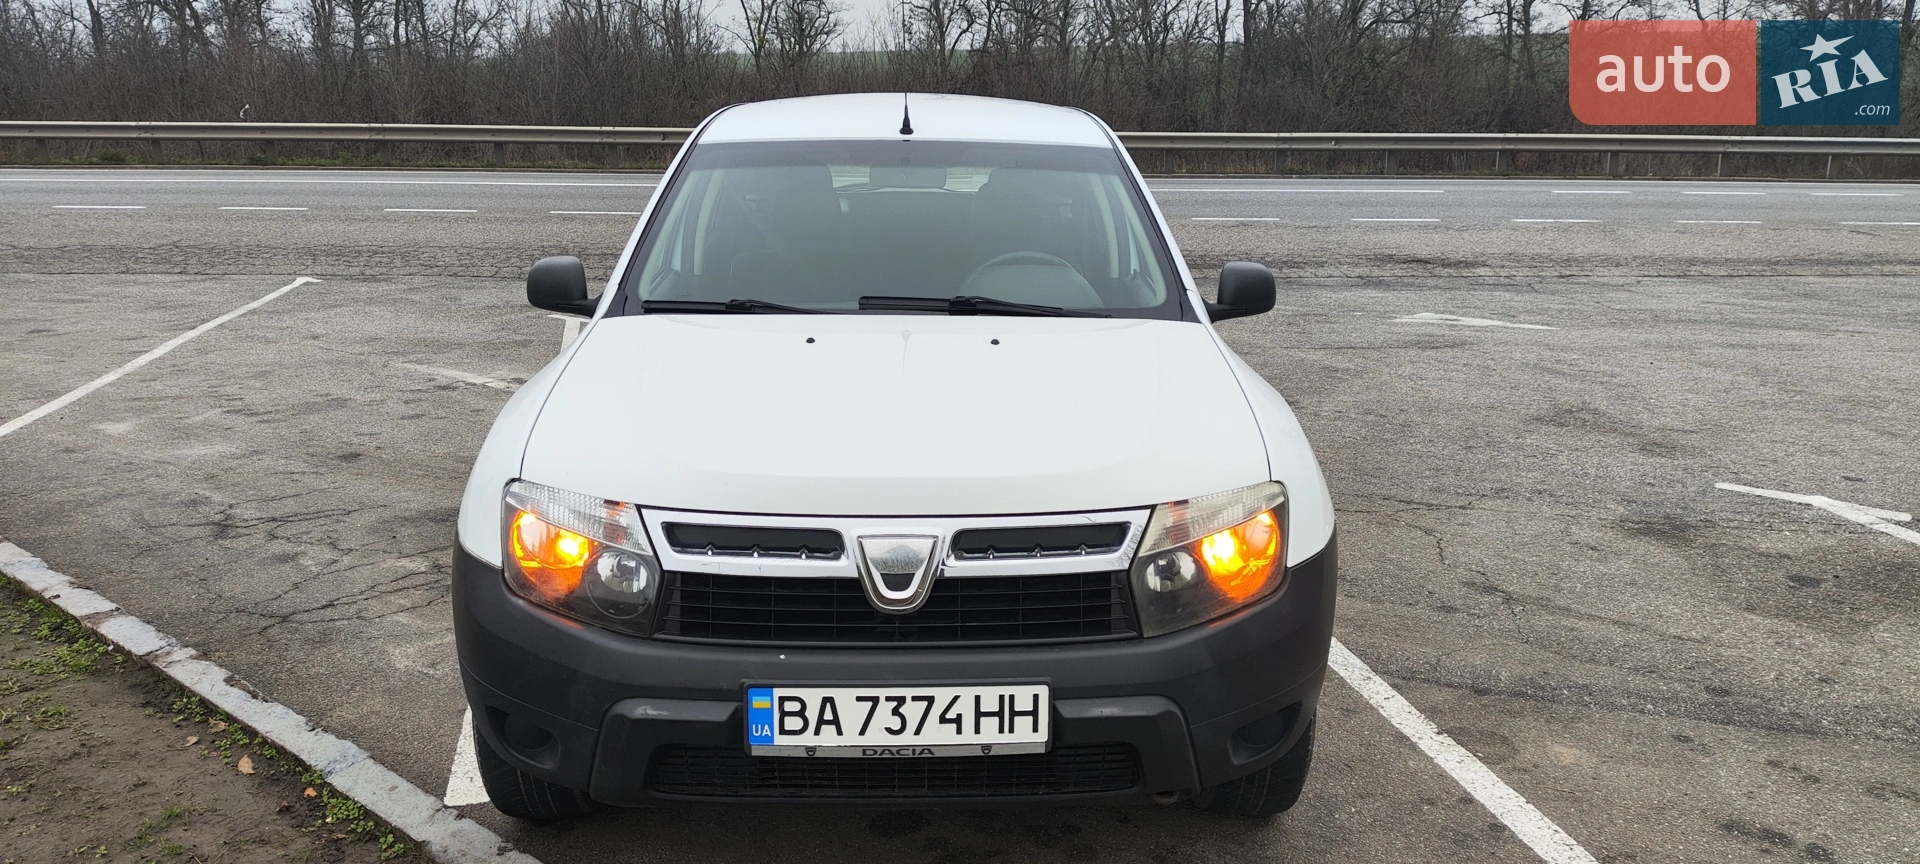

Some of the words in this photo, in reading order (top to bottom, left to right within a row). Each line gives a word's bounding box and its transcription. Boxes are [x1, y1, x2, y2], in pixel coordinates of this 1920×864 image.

[778, 695, 844, 736] BA
[855, 694, 963, 736] 7374
[974, 693, 1040, 735] HH
[752, 724, 772, 737] UA
[861, 747, 936, 757] DACIA
